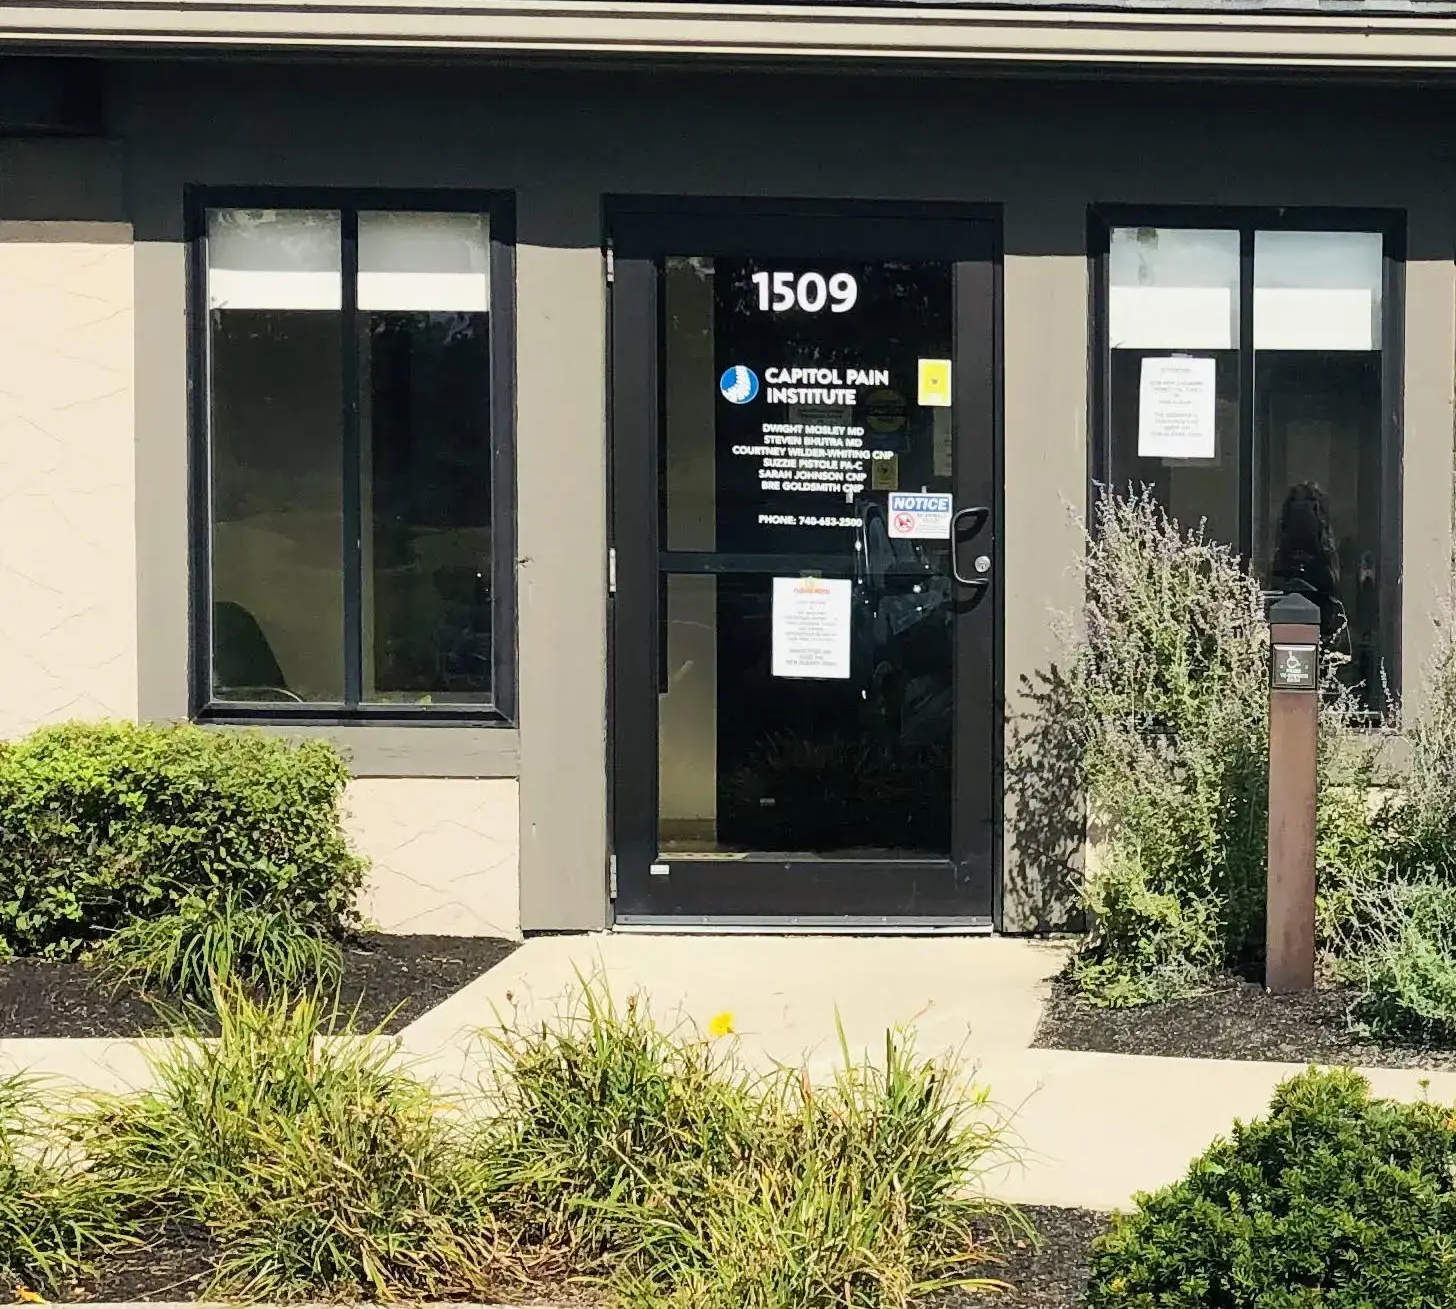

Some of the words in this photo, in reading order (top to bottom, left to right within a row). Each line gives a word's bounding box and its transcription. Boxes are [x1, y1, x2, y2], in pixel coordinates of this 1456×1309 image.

[751, 272, 858, 313] 1509
[764, 367, 843, 385] CAPITOL
[846, 369, 889, 386] PAIN
[766, 388, 857, 405] INSTITUTE
[763, 424, 803, 434] DWIGHT
[805, 425, 846, 435] MOSLEY
[847, 427, 864, 436] MD
[764, 435, 801, 445] STEVEN
[845, 438, 863, 447] MD
[732, 446, 786, 456] COURTNEY
[788, 447, 870, 459] WILDER-WHITING
[872, 451, 894, 460] CNP
[840, 461, 863, 470] PA-C
[758, 469, 792, 479] SARAH
[794, 471, 843, 481] JOHNSON
[845, 473, 867, 482] CNP
[761, 481, 780, 490] BRE
[782, 481, 840, 492] GOLDSMITH
[843, 484, 864, 493] CNP
[893, 497, 949, 511] NOTICE
[758, 515, 796, 525] PHONE:
